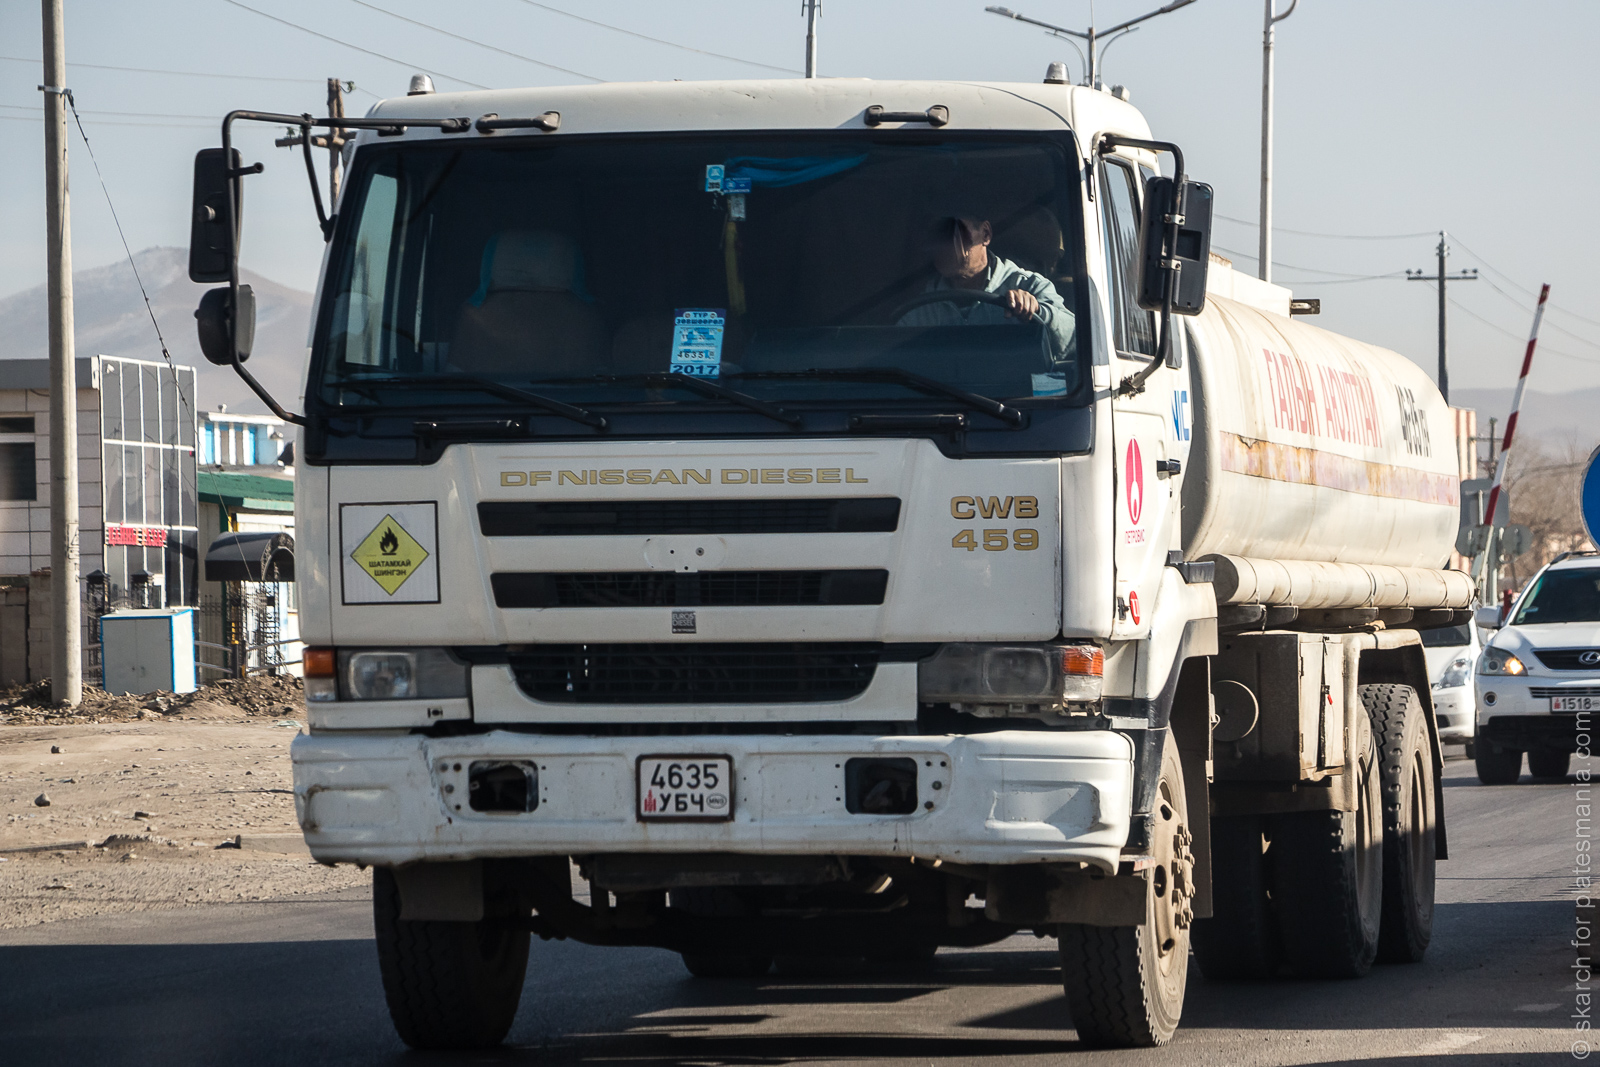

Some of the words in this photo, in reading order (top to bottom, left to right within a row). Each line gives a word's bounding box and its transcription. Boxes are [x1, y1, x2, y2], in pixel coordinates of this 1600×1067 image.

[677, 351, 704, 359] 4635
[673, 365, 718, 375] 2017
[1262, 348, 1321, 437] ГАЛЫН
[558, 469, 711, 485] NISSAN
[720, 468, 869, 484] DIESEL
[951, 496, 1039, 519] CWB
[952, 529, 1039, 551] 459
[369, 559, 411, 567] ШАТАМХАЙ
[1561, 698, 1591, 710] 1518
[651, 763, 719, 789] 4635
[659, 793, 704, 812] УБЧ
